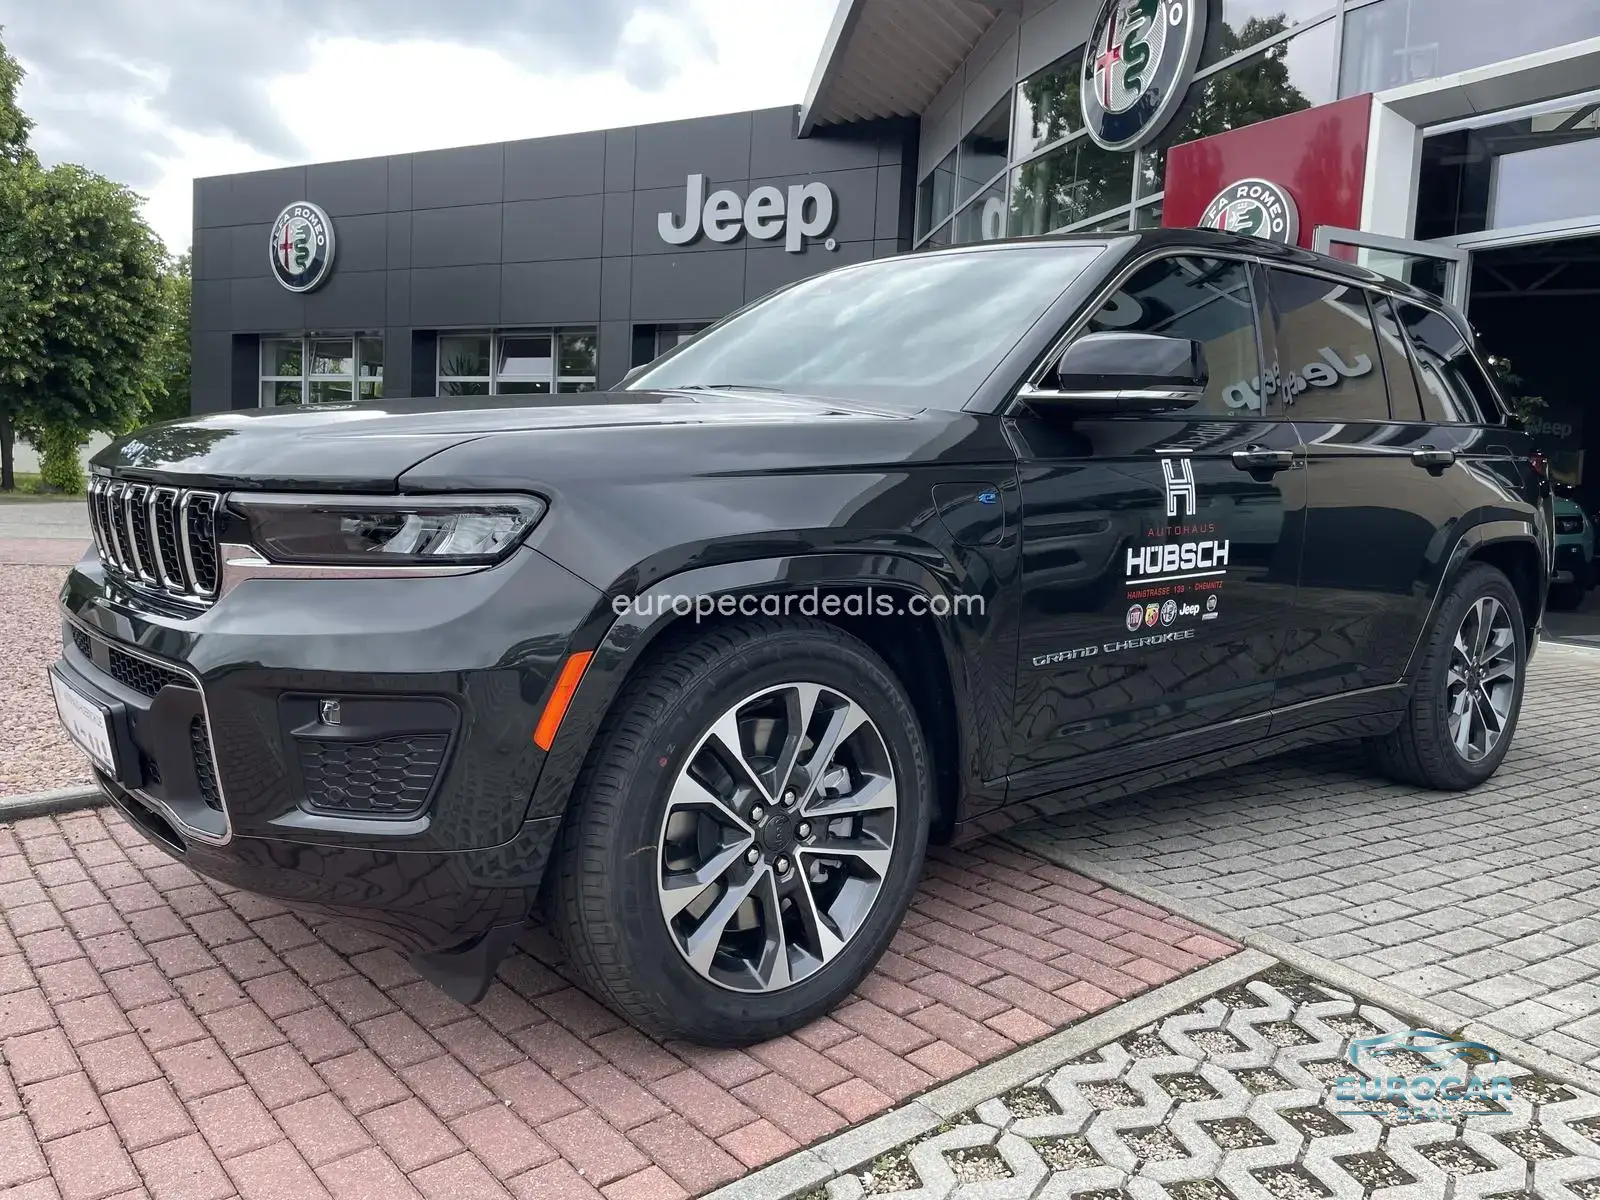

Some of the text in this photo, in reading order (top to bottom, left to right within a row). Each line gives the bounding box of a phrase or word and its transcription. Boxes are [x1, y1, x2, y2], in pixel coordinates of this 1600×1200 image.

[657, 173, 833, 252] Jeep
[1236, 185, 1284, 233] ROMEO
[272, 207, 325, 252] ALFA ROMEO
[1147, 523, 1216, 537] AUTOHAUS
[1126, 540, 1229, 576] HÜBSCH
[1194, 580, 1223, 591] CHEMNITZ
[1179, 603, 1200, 616] Jeep
[1032, 628, 1197, 667] GRAND CHEROKEE
